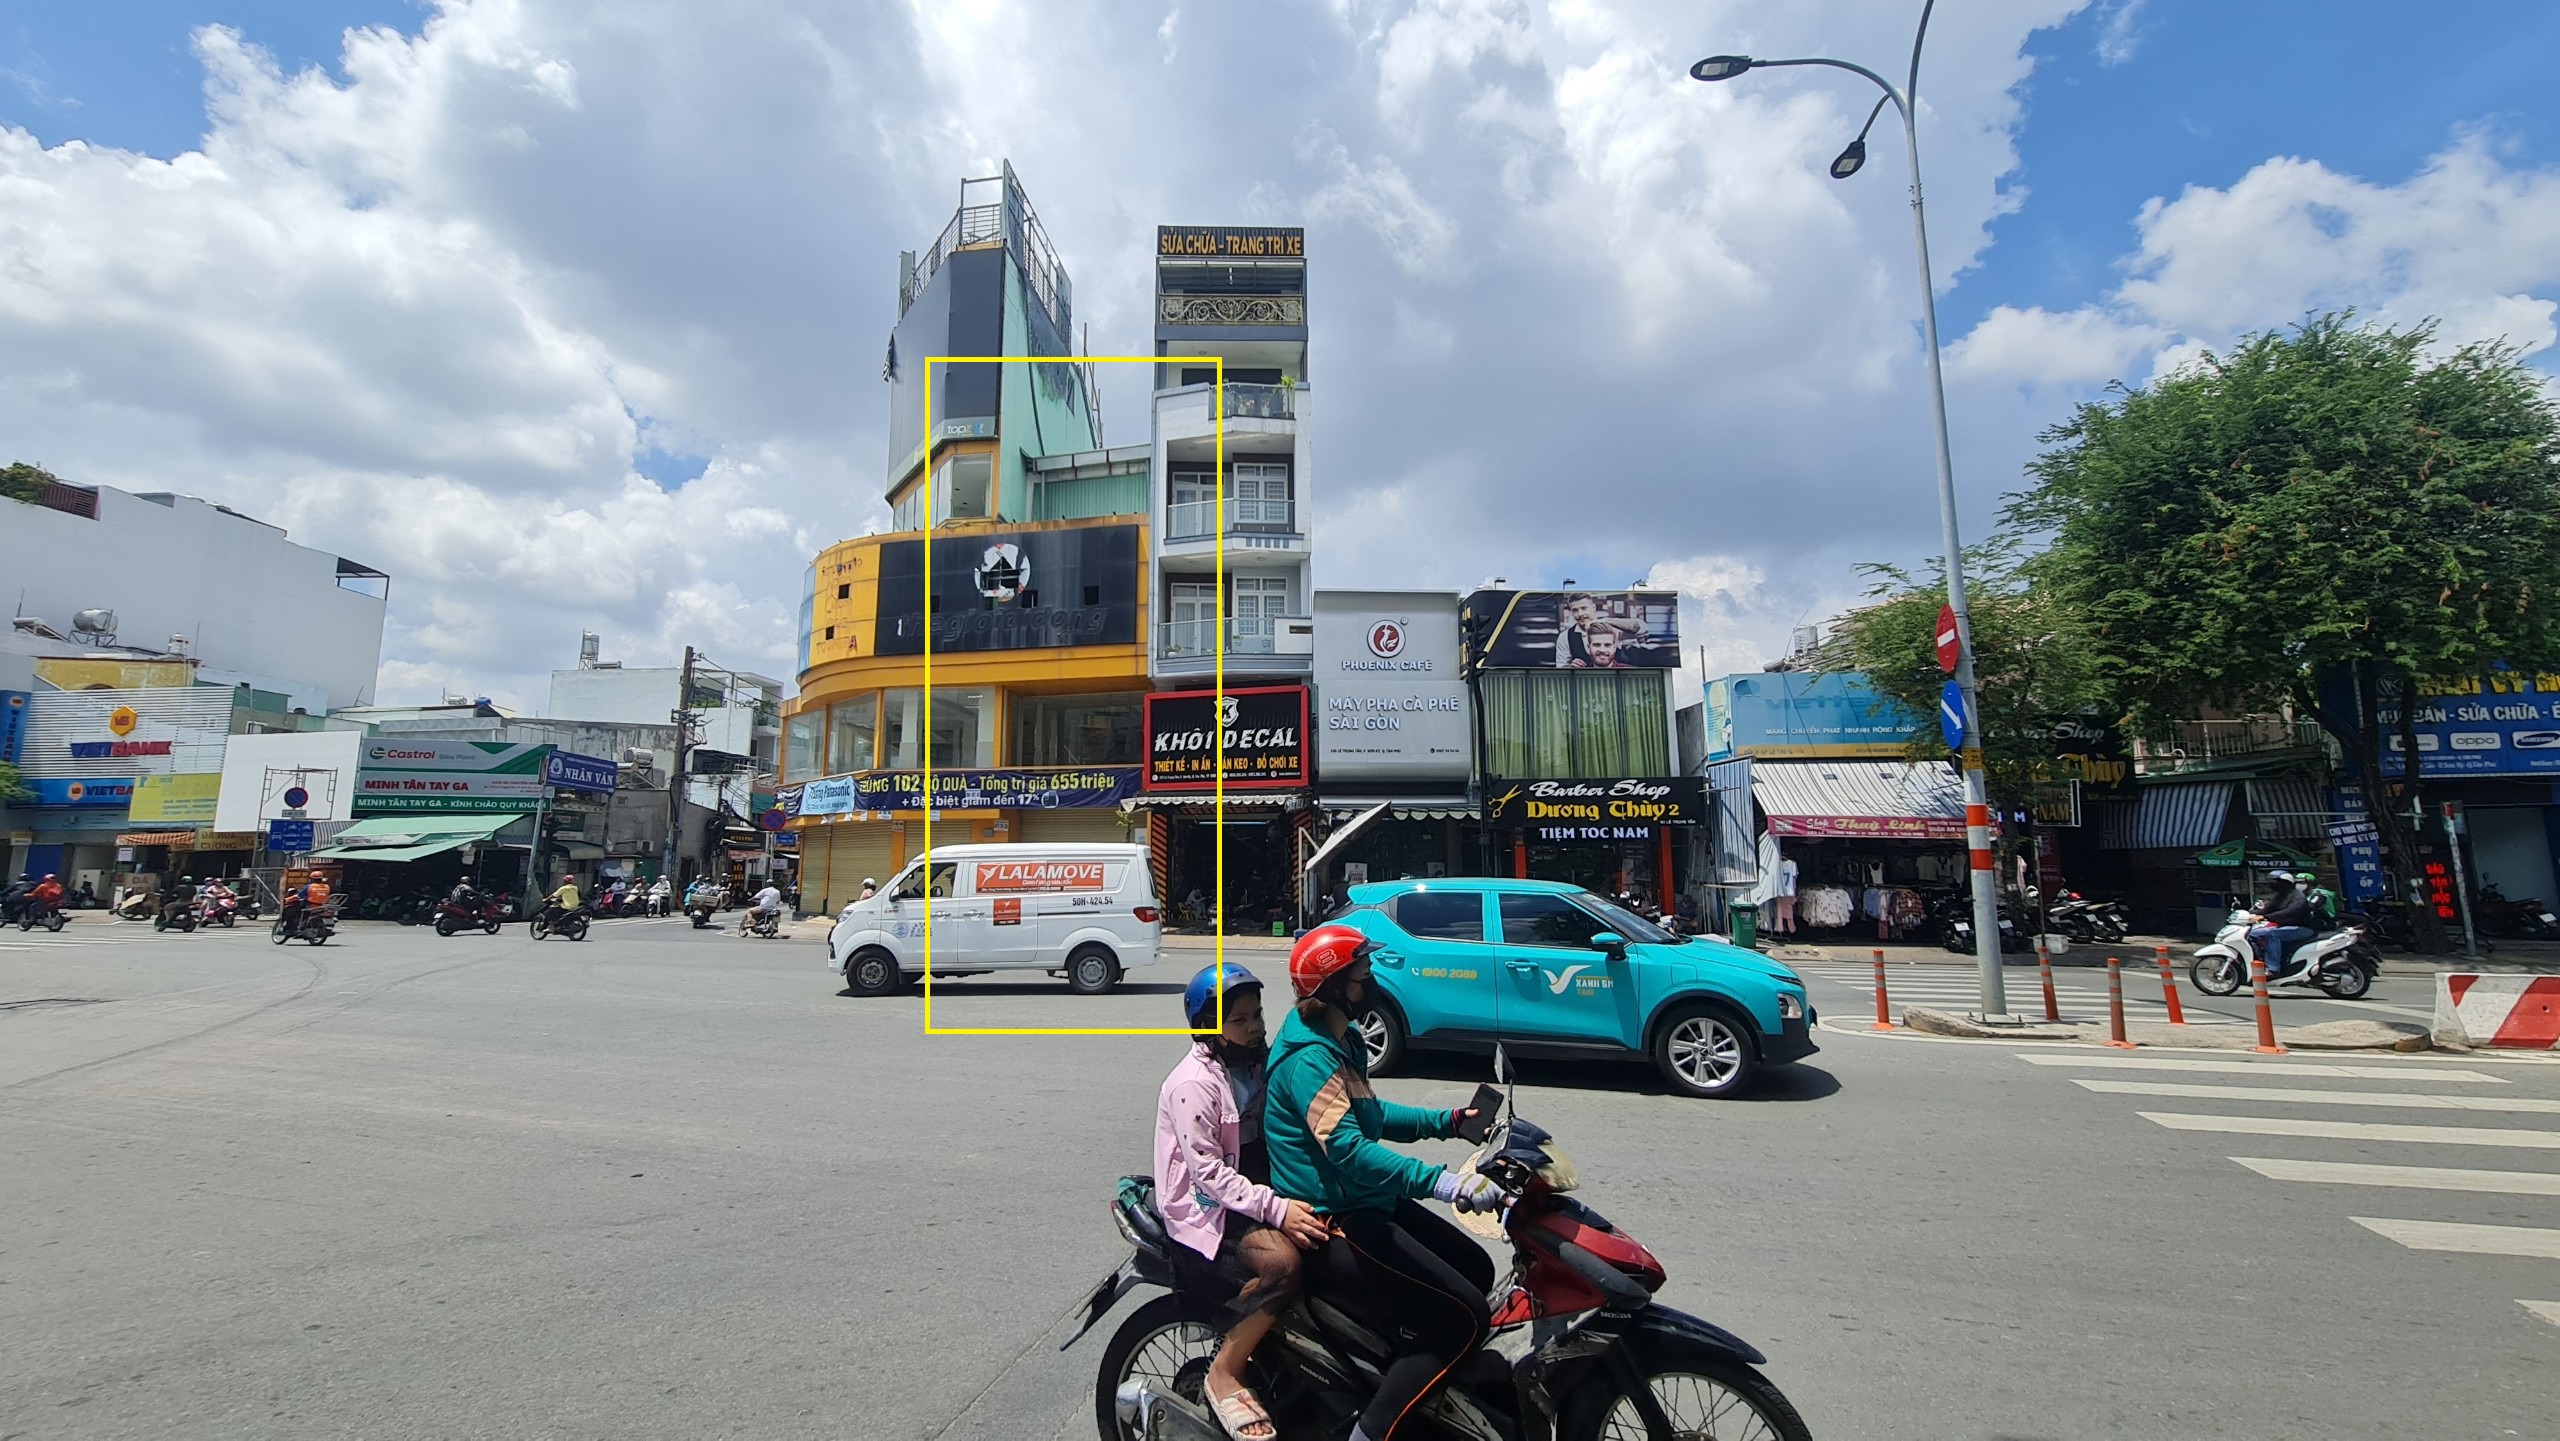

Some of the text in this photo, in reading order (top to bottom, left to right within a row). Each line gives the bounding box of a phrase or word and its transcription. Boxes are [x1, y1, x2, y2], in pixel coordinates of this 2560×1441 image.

[1161, 227, 1184, 254] SỬA
[1186, 230, 1217, 254] CHỮA
[1226, 236, 1264, 255] TRANG
[1266, 230, 1286, 255] TRÍ
[1286, 236, 1301, 255] XE
[1341, 660, 1397, 671] PHOENIX
[1329, 694, 1459, 711] MÁY PHA CÀ PHÊ
[2457, 702, 2491, 721] SỬA
[2493, 702, 2540, 720] CHỮA
[1329, 713, 1400, 730] SÀI GÒN
[1154, 726, 1298, 752] KHÔI DECAL
[2054, 721, 2104, 745] Shop
[71, 741, 173, 758] VIETBANK
[387, 749, 436, 760] Castrol
[1154, 756, 1175, 772] THIẾT
[1176, 755, 1186, 771] KẾ
[1192, 759, 1199, 771] IN
[1234, 757, 1249, 770] KEO
[1269, 755, 1287, 768] CHƠI
[1288, 756, 1298, 768] XE
[364, 779, 469, 791] MINH TÂN TAY GA
[564, 767, 593, 783] NHÂN
[594, 771, 614, 786] VĂN
[893, 775, 920, 792] 102
[943, 774, 968, 790] QUÀ
[979, 774, 1008, 794] Tổng
[1011, 776, 1026, 793] trị
[1028, 776, 1047, 794] giá
[1051, 773, 1079, 790] 655
[1080, 773, 1115, 792] triệu
[1528, 779, 1671, 800] Barber Shop
[388, 798, 408, 807] TÂN
[409, 799, 429, 807] TAY
[428, 799, 442, 807] GA
[450, 799, 473, 808] KÍNH
[474, 798, 498, 808] CHÀO
[936, 793, 960, 807] biệt
[992, 791, 1015, 806] đến
[1524, 799, 1680, 822] Dương Thùy 2
[2038, 803, 2070, 821] NAM
[1806, 818, 1830, 829] Shop
[1538, 826, 1575, 842] TIỆM
[1613, 825, 1649, 839] NAM
[998, 864, 1102, 880] LALAMOVE
[2353, 860, 2377, 872] KIỆN
[1575, 978, 1614, 989] XANH SM
[1600, 1311, 1632, 1319] HONDA
